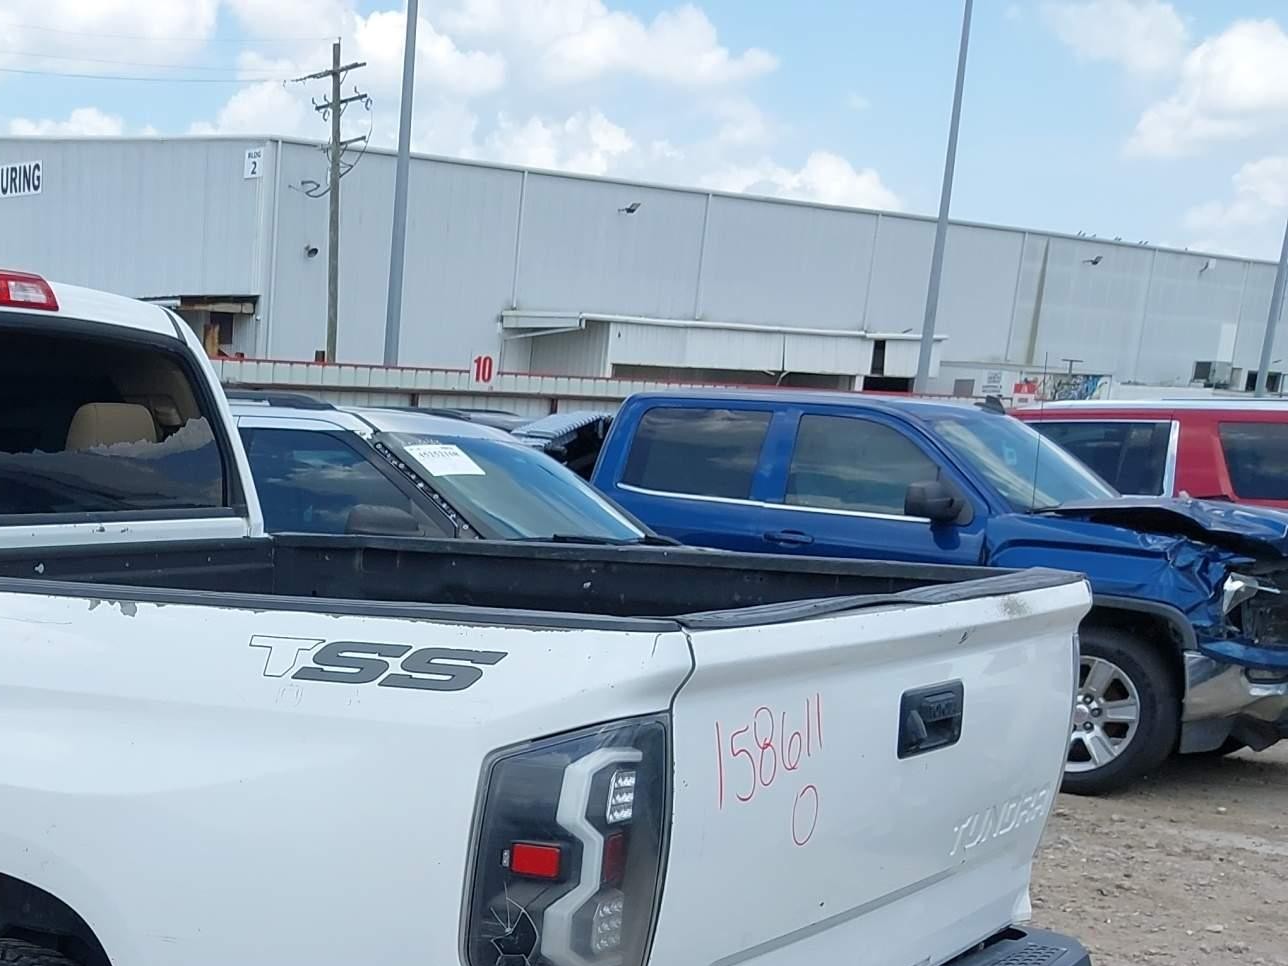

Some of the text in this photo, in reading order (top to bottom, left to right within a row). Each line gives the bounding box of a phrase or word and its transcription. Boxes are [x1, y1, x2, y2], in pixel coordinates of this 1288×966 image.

[251, 160, 257, 175] 2
[474, 356, 493, 383] 10
[249, 634, 509, 692] TSS
[715, 692, 823, 811] 158611
[792, 784, 819, 846] 0
